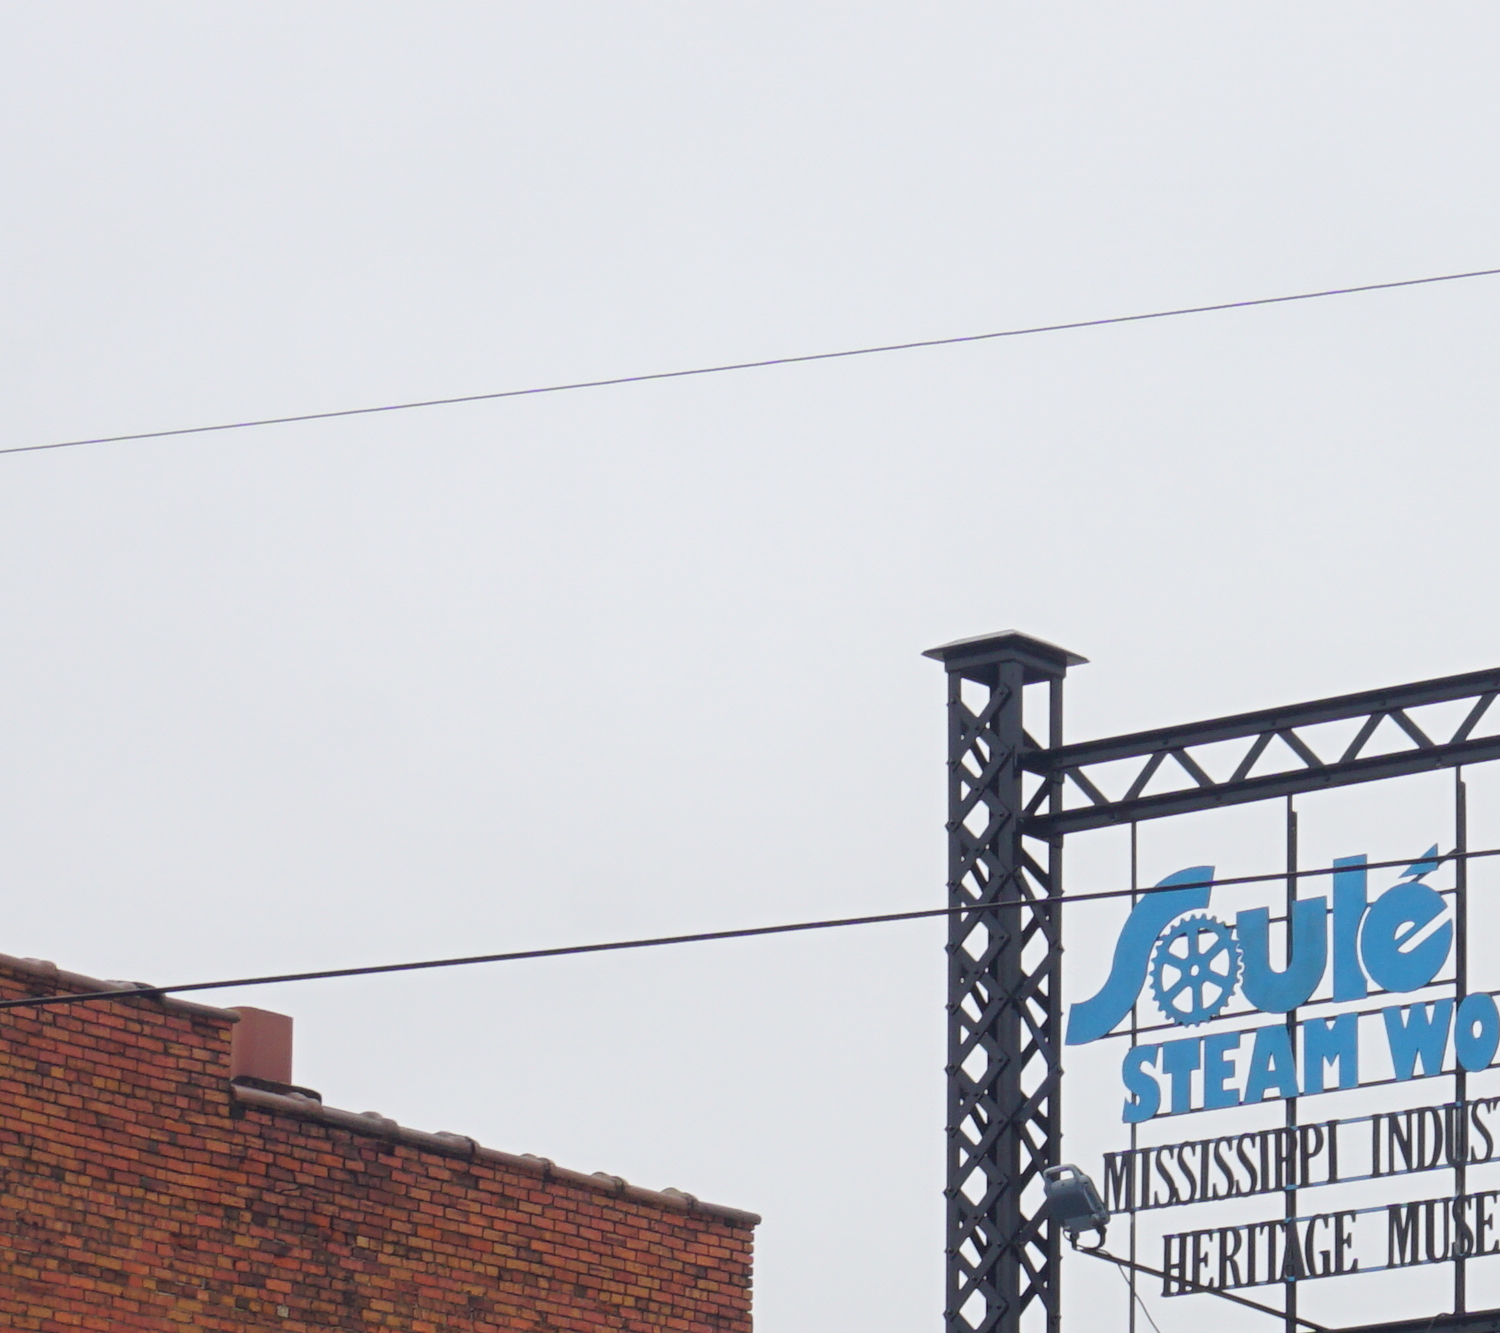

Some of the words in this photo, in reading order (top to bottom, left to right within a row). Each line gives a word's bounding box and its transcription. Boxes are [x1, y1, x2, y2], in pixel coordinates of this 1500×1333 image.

[1122, 1012, 1359, 1123] STEAM
[1103, 1119, 1340, 1214] MISSISSIPPI
[1162, 1210, 1359, 1296] HERITAGE
